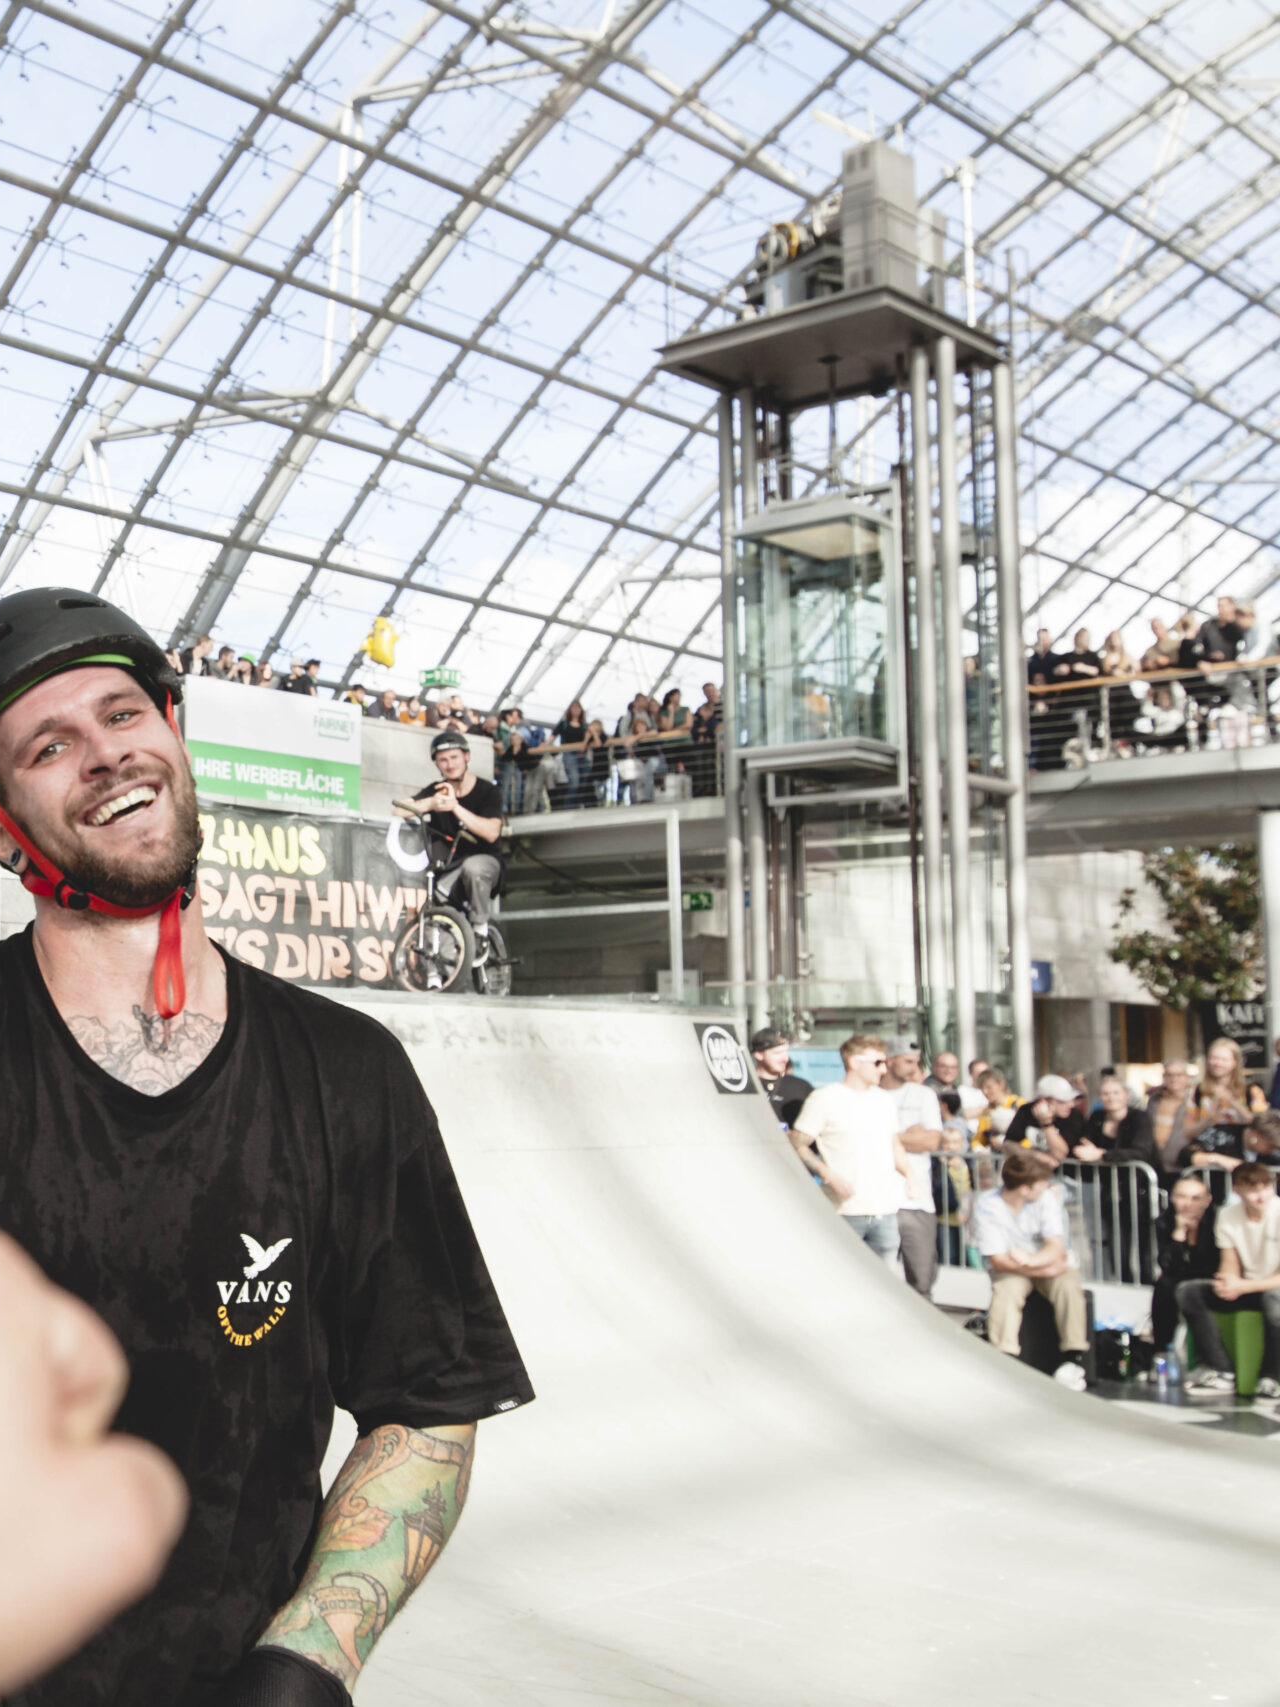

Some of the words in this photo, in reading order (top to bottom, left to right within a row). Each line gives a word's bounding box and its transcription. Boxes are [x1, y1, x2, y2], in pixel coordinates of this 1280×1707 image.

[194, 757, 232, 780] IHRE
[234, 762, 344, 796] WERBEFLÄCHE
[197, 867, 302, 924] SAGT
[273, 932, 352, 981] DIR
[216, 1280, 293, 1305] VANS
[217, 1305, 233, 1336] OFF
[229, 1331, 252, 1347] THE
[253, 1306, 286, 1341] WALL
